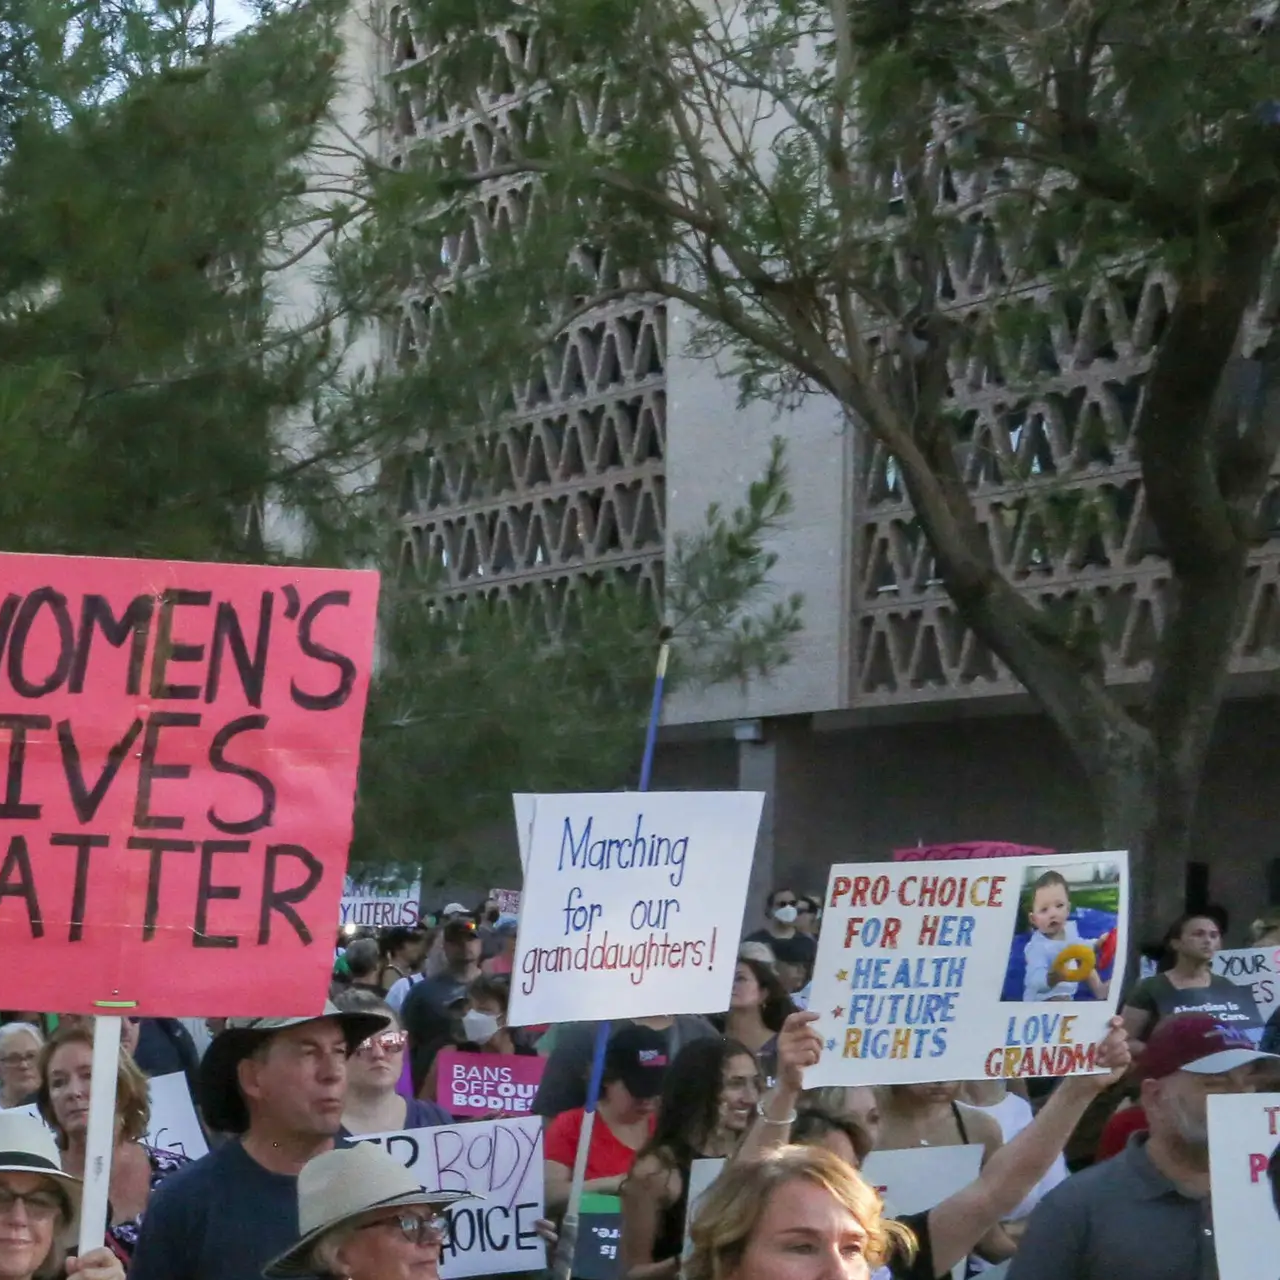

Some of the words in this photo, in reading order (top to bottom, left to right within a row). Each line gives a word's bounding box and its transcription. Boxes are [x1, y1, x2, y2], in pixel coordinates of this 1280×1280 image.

[558, 814, 689, 887] Marching
[829, 875, 1007, 908] PRO-CHOICE
[353, 901, 419, 926] UTERUS
[563, 887, 602, 936] for
[630, 899, 680, 930] our
[844, 917, 901, 949] FOR
[918, 914, 975, 947] HER
[522, 926, 717, 995] granddaughters!
[851, 956, 967, 990] HEALTH
[1219, 954, 1271, 977] YOUR
[848, 992, 960, 1025] FUTURE
[842, 1027, 948, 1059] RIGHTS
[1005, 1013, 1078, 1046] LOVE
[451, 1080, 495, 1095] OFF
[497, 1083, 539, 1098] OU
[453, 1064, 512, 1082] BANS
